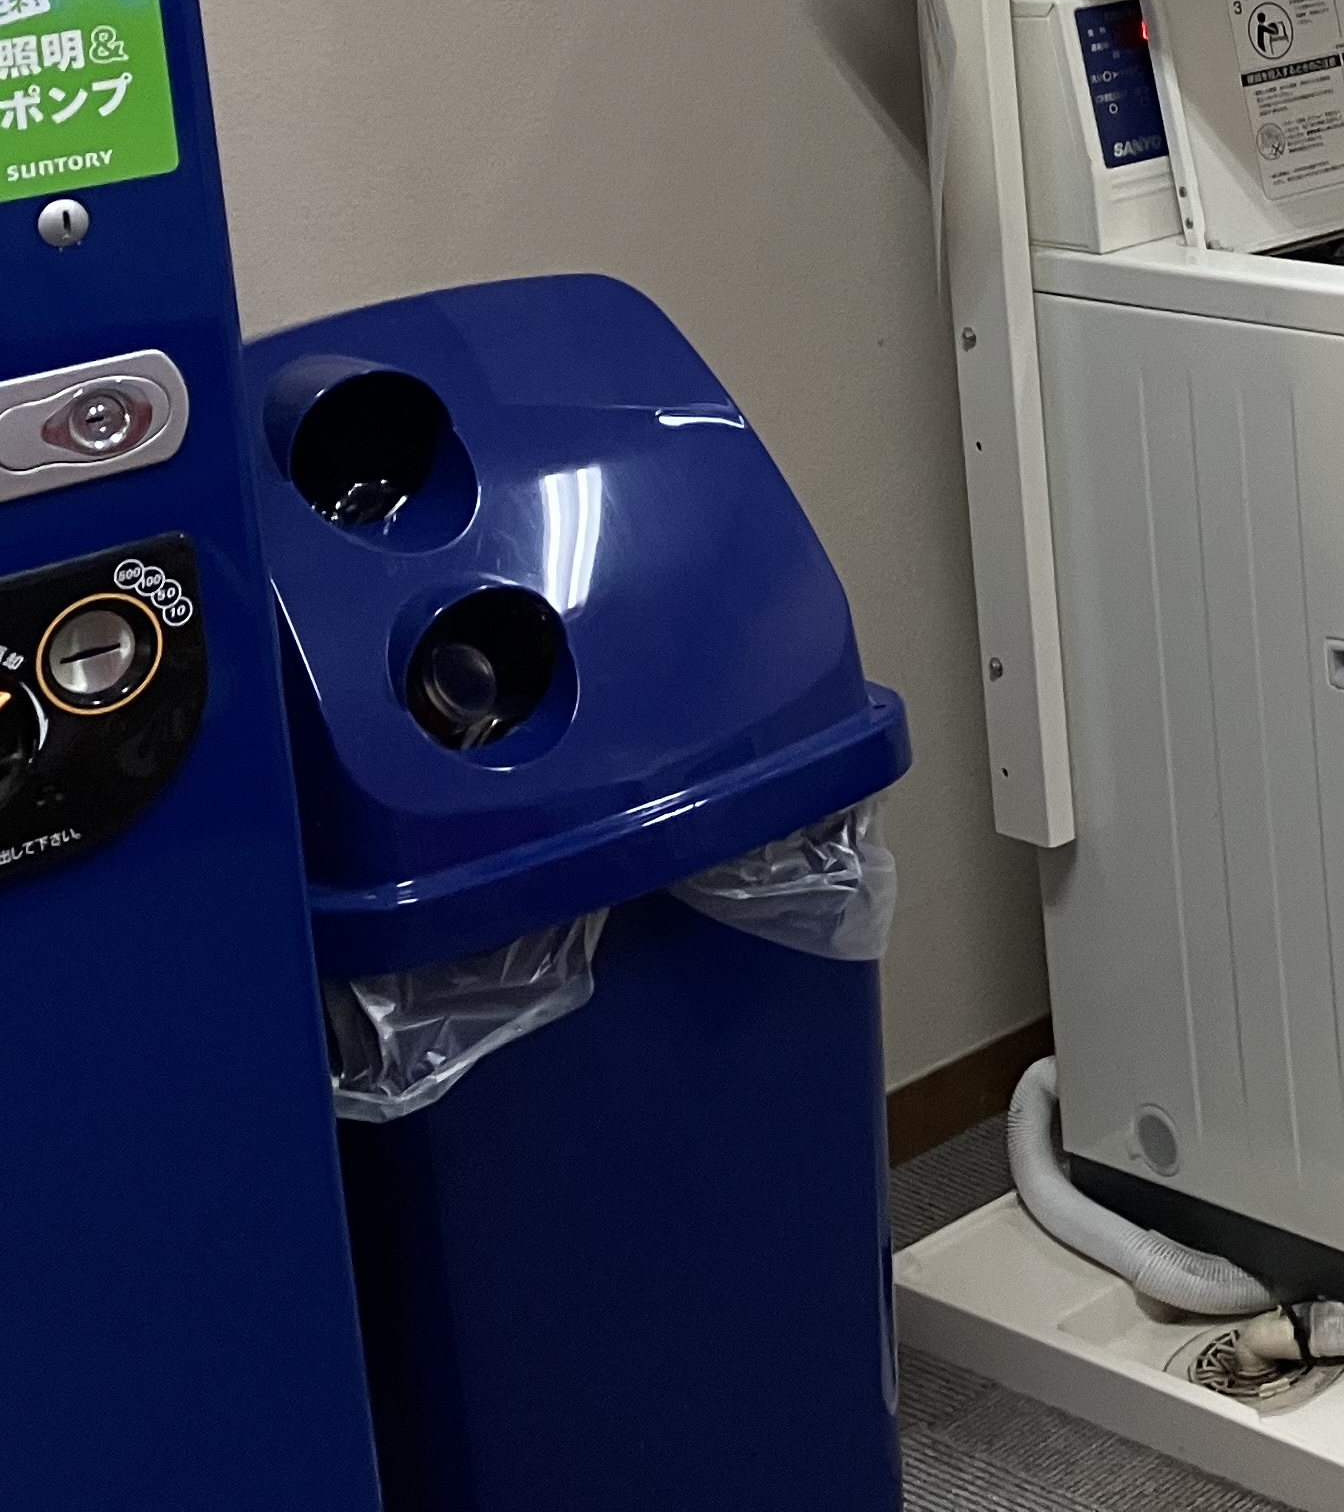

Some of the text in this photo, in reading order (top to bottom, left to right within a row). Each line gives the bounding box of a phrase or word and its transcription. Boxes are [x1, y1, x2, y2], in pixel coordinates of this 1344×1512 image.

[1233, 0, 1243, 15] 3
[0, 72, 133, 131] ポンプ
[7, 149, 113, 182] SUNTORY
[118, 567, 141, 583] 500
[141, 574, 162, 589] 100
[157, 586, 176, 601] 50
[169, 604, 186, 619] 10
